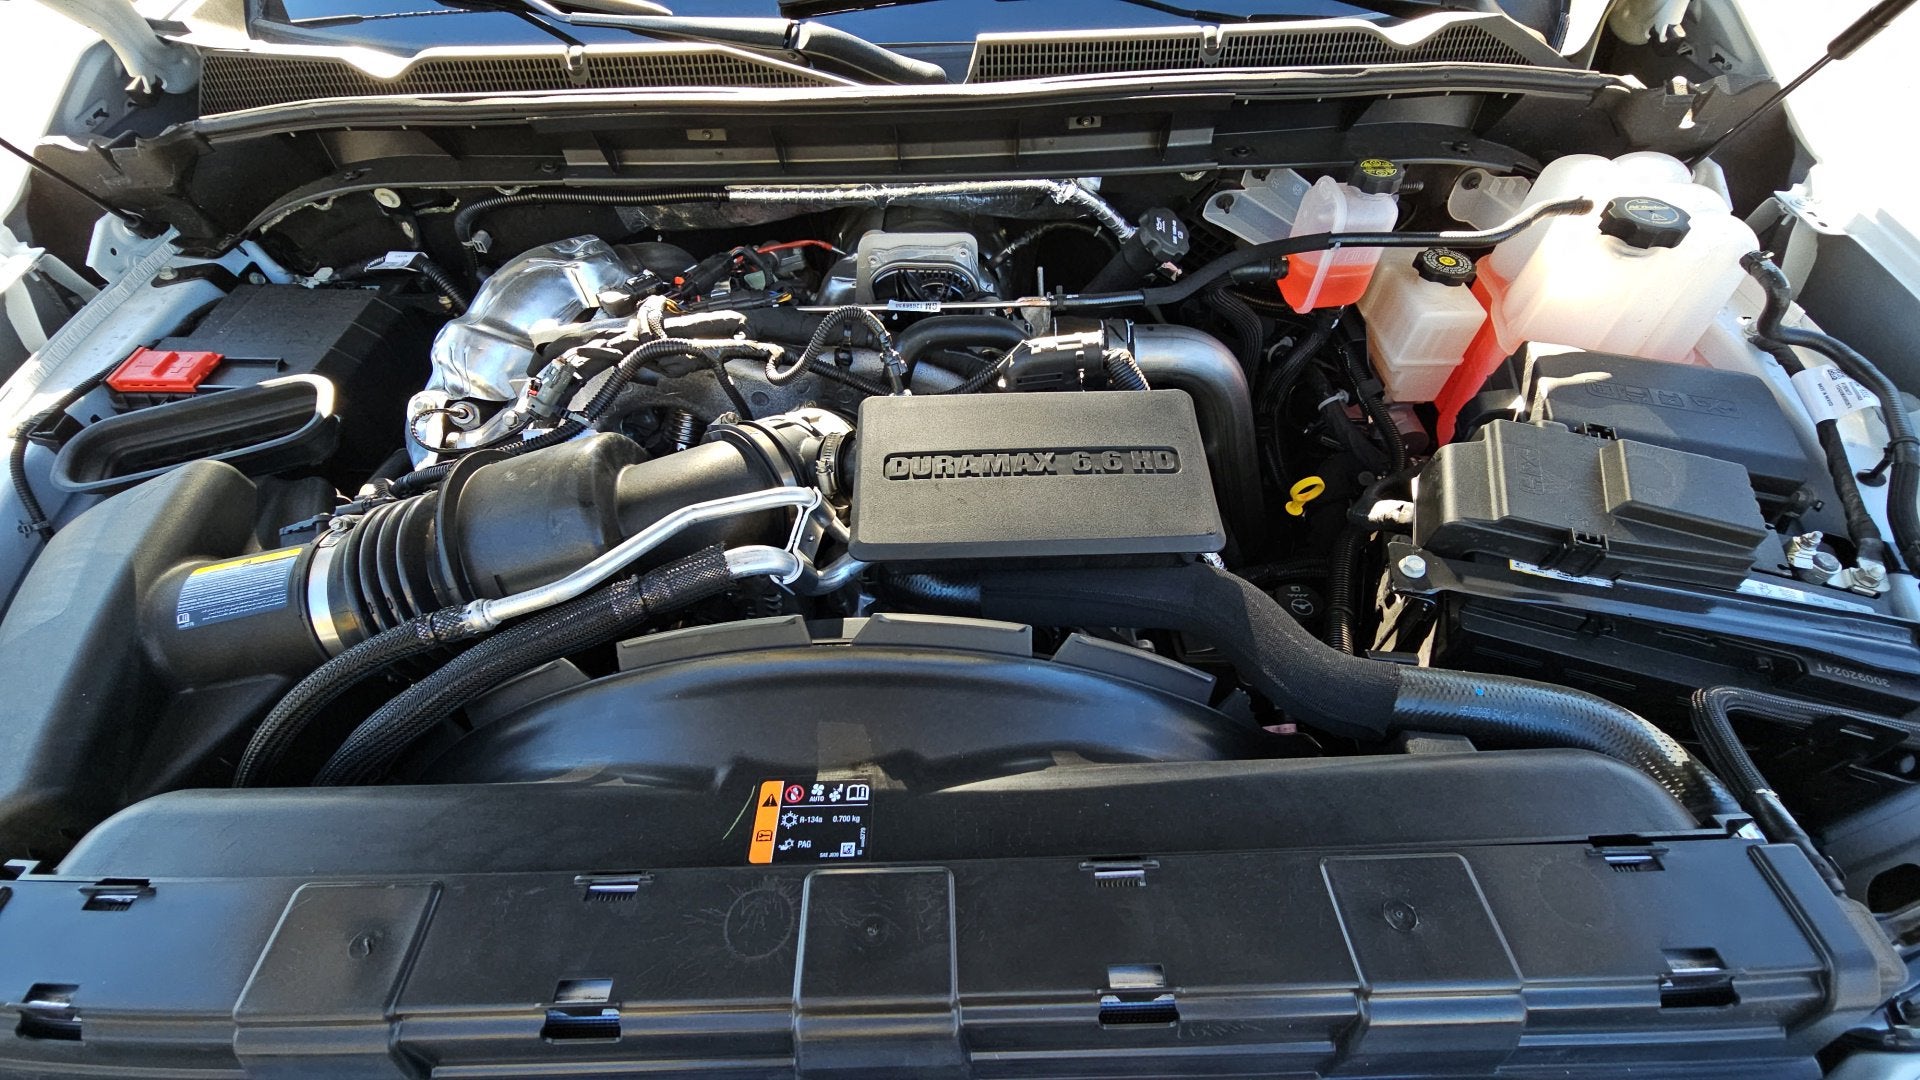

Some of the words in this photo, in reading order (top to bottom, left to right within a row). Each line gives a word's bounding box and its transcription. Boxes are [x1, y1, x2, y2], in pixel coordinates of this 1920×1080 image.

[889, 452, 1057, 479] DURAMAX
[1071, 451, 1124, 474] 6.6
[1130, 450, 1177, 473] HD
[1816, 663, 1891, 688] 30092024T
[852, 815, 861, 823] kg
[797, 840, 812, 849] PAG
